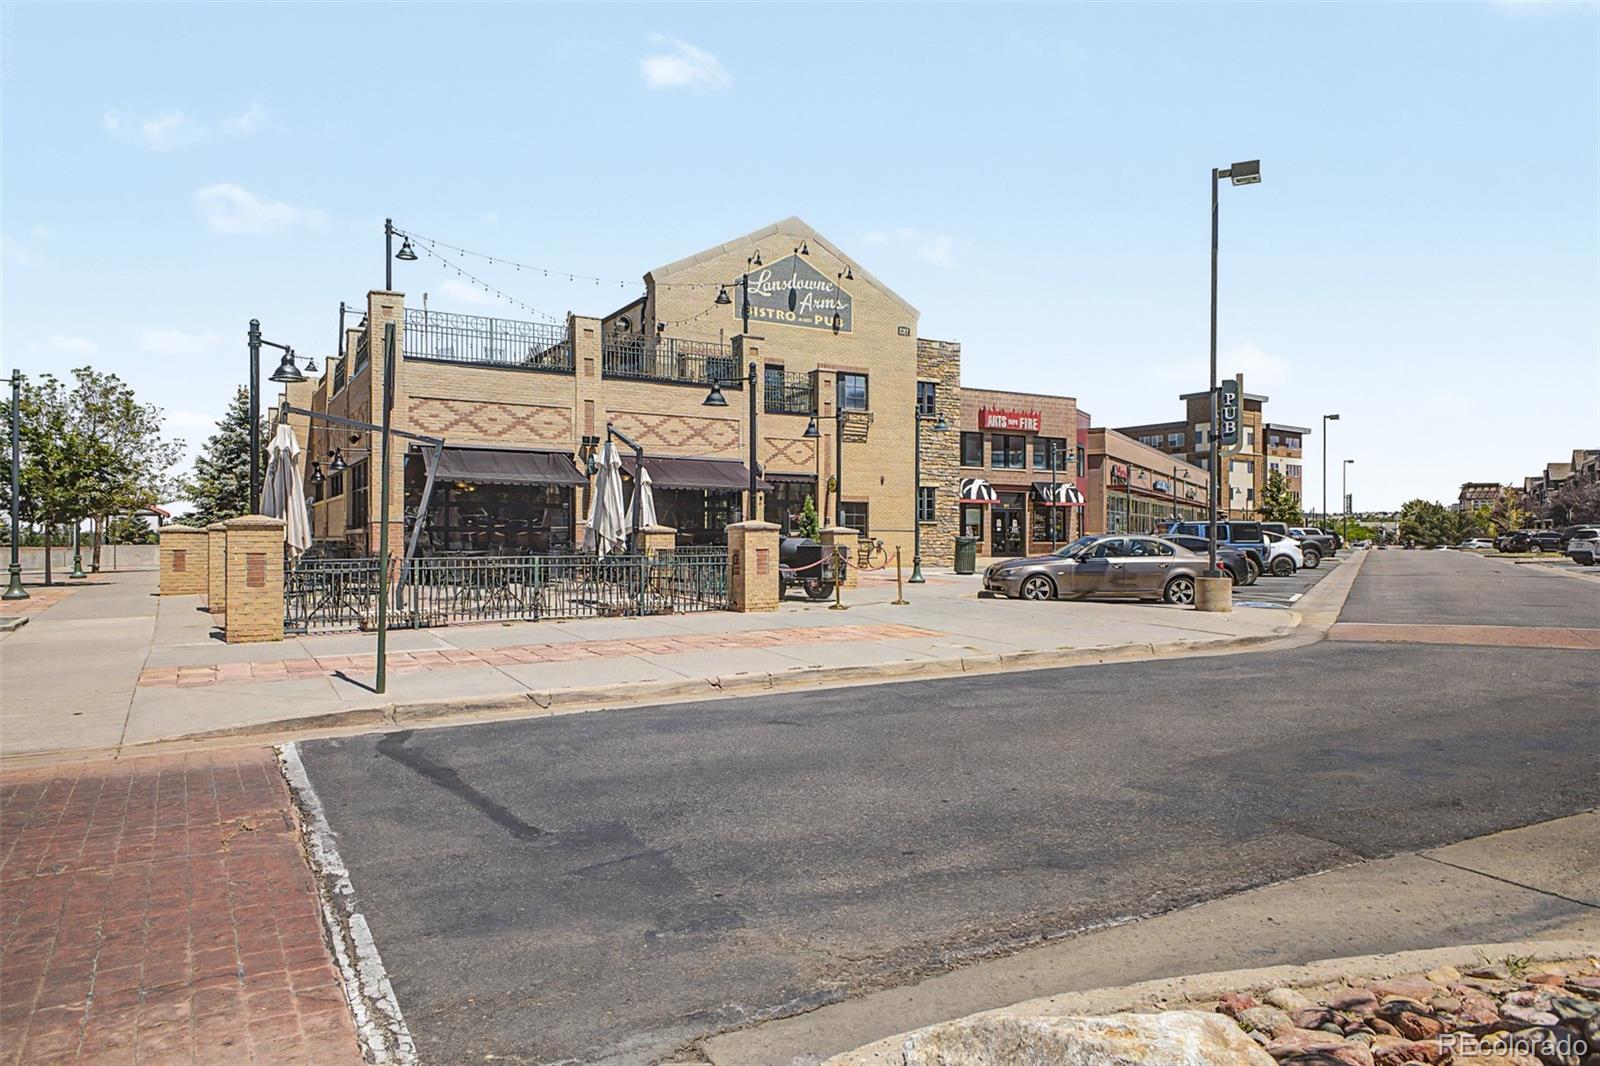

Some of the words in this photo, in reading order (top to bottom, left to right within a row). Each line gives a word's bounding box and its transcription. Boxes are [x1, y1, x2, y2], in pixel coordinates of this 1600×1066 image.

[748, 269, 834, 296] Lansdowne
[799, 292, 849, 315] Arms
[814, 314, 844, 328] PUB
[987, 414, 1007, 428] ARTS
[1019, 417, 1039, 430] FIRE
[1224, 392, 1237, 434] PUB
